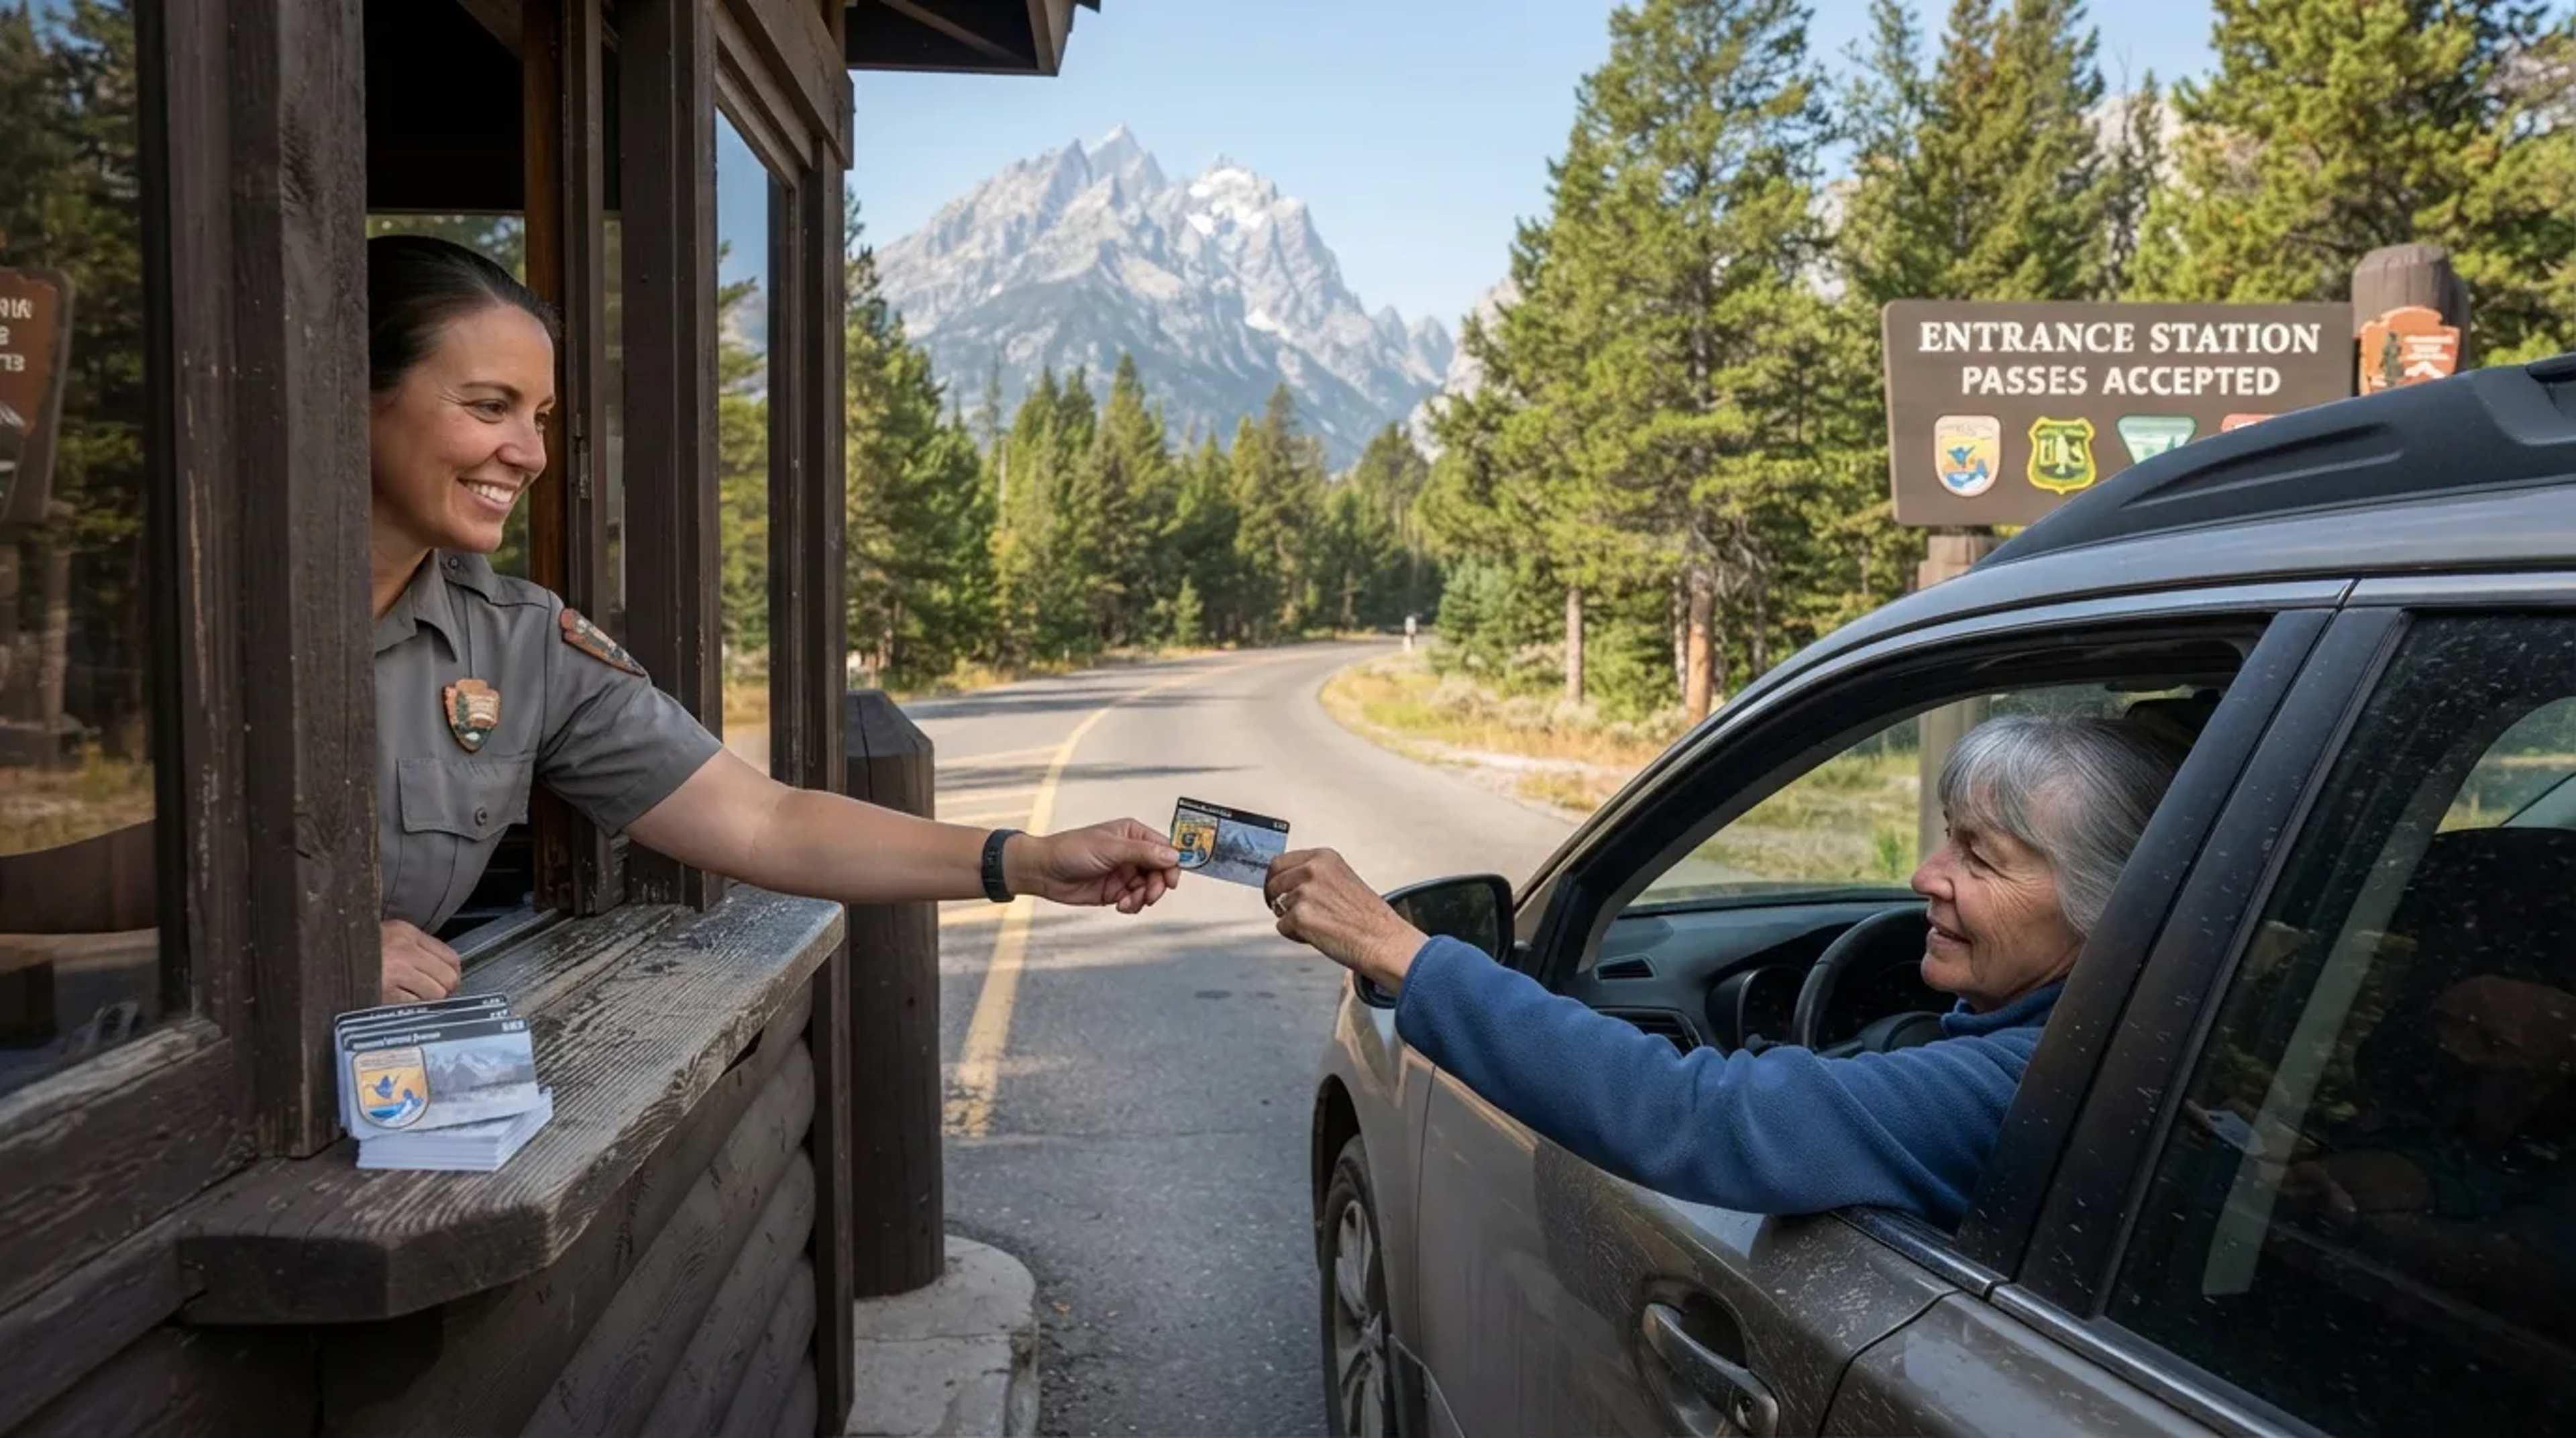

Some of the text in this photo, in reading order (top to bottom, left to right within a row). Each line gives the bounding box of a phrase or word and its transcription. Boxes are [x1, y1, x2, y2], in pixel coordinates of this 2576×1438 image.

[1918, 321, 2321, 354] ENTRANCE STATION
[1962, 366, 2282, 395] PASSES ACCEPTED
